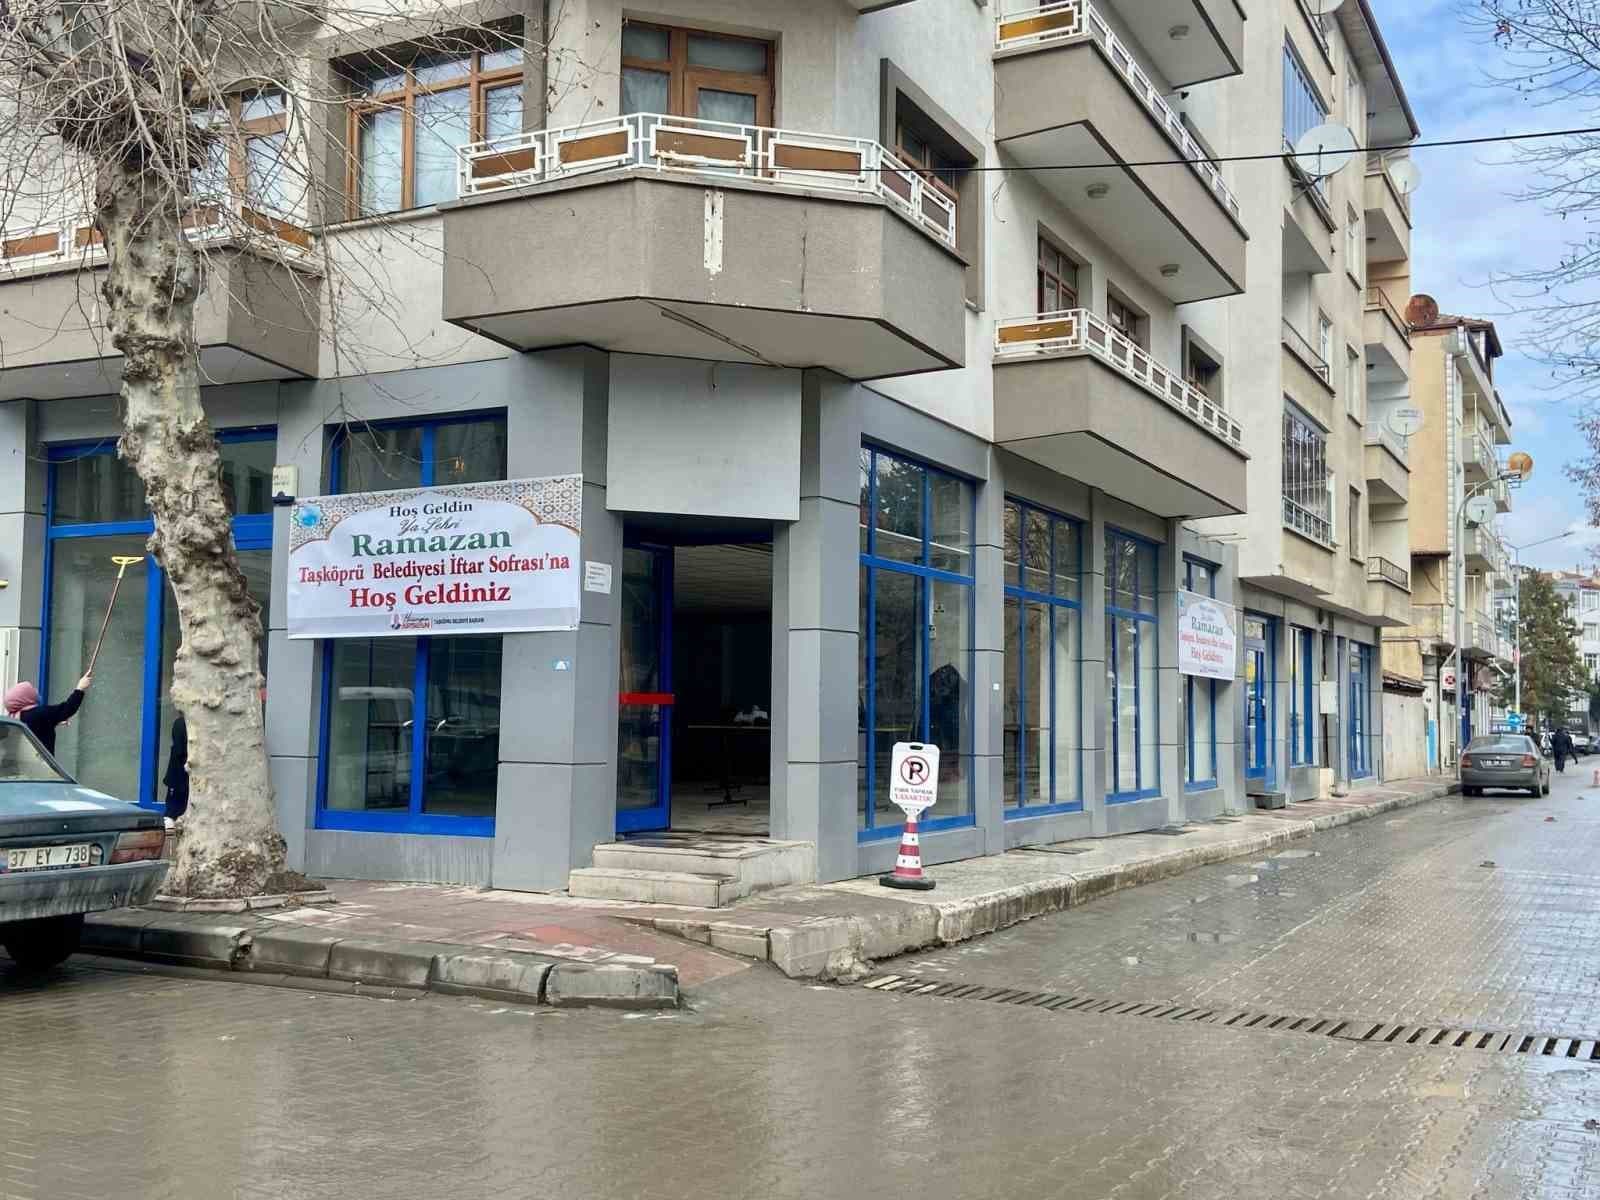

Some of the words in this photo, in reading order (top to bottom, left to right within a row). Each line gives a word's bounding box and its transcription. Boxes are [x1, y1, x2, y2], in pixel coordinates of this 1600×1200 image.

[390, 506, 418, 519] Hoş
[423, 501, 472, 515] Geldin
[351, 530, 513, 557] Ramazan
[299, 564, 364, 587] Taşköprü
[373, 559, 446, 583] Belediyesi
[450, 554, 485, 575] İftar
[489, 552, 570, 574] Sofrası'na
[349, 587, 397, 611] Hoş
[404, 581, 512, 606] Geldiniz
[10, 851, 27, 867] 37
[36, 848, 51, 865] EY
[65, 846, 87, 863] 738
